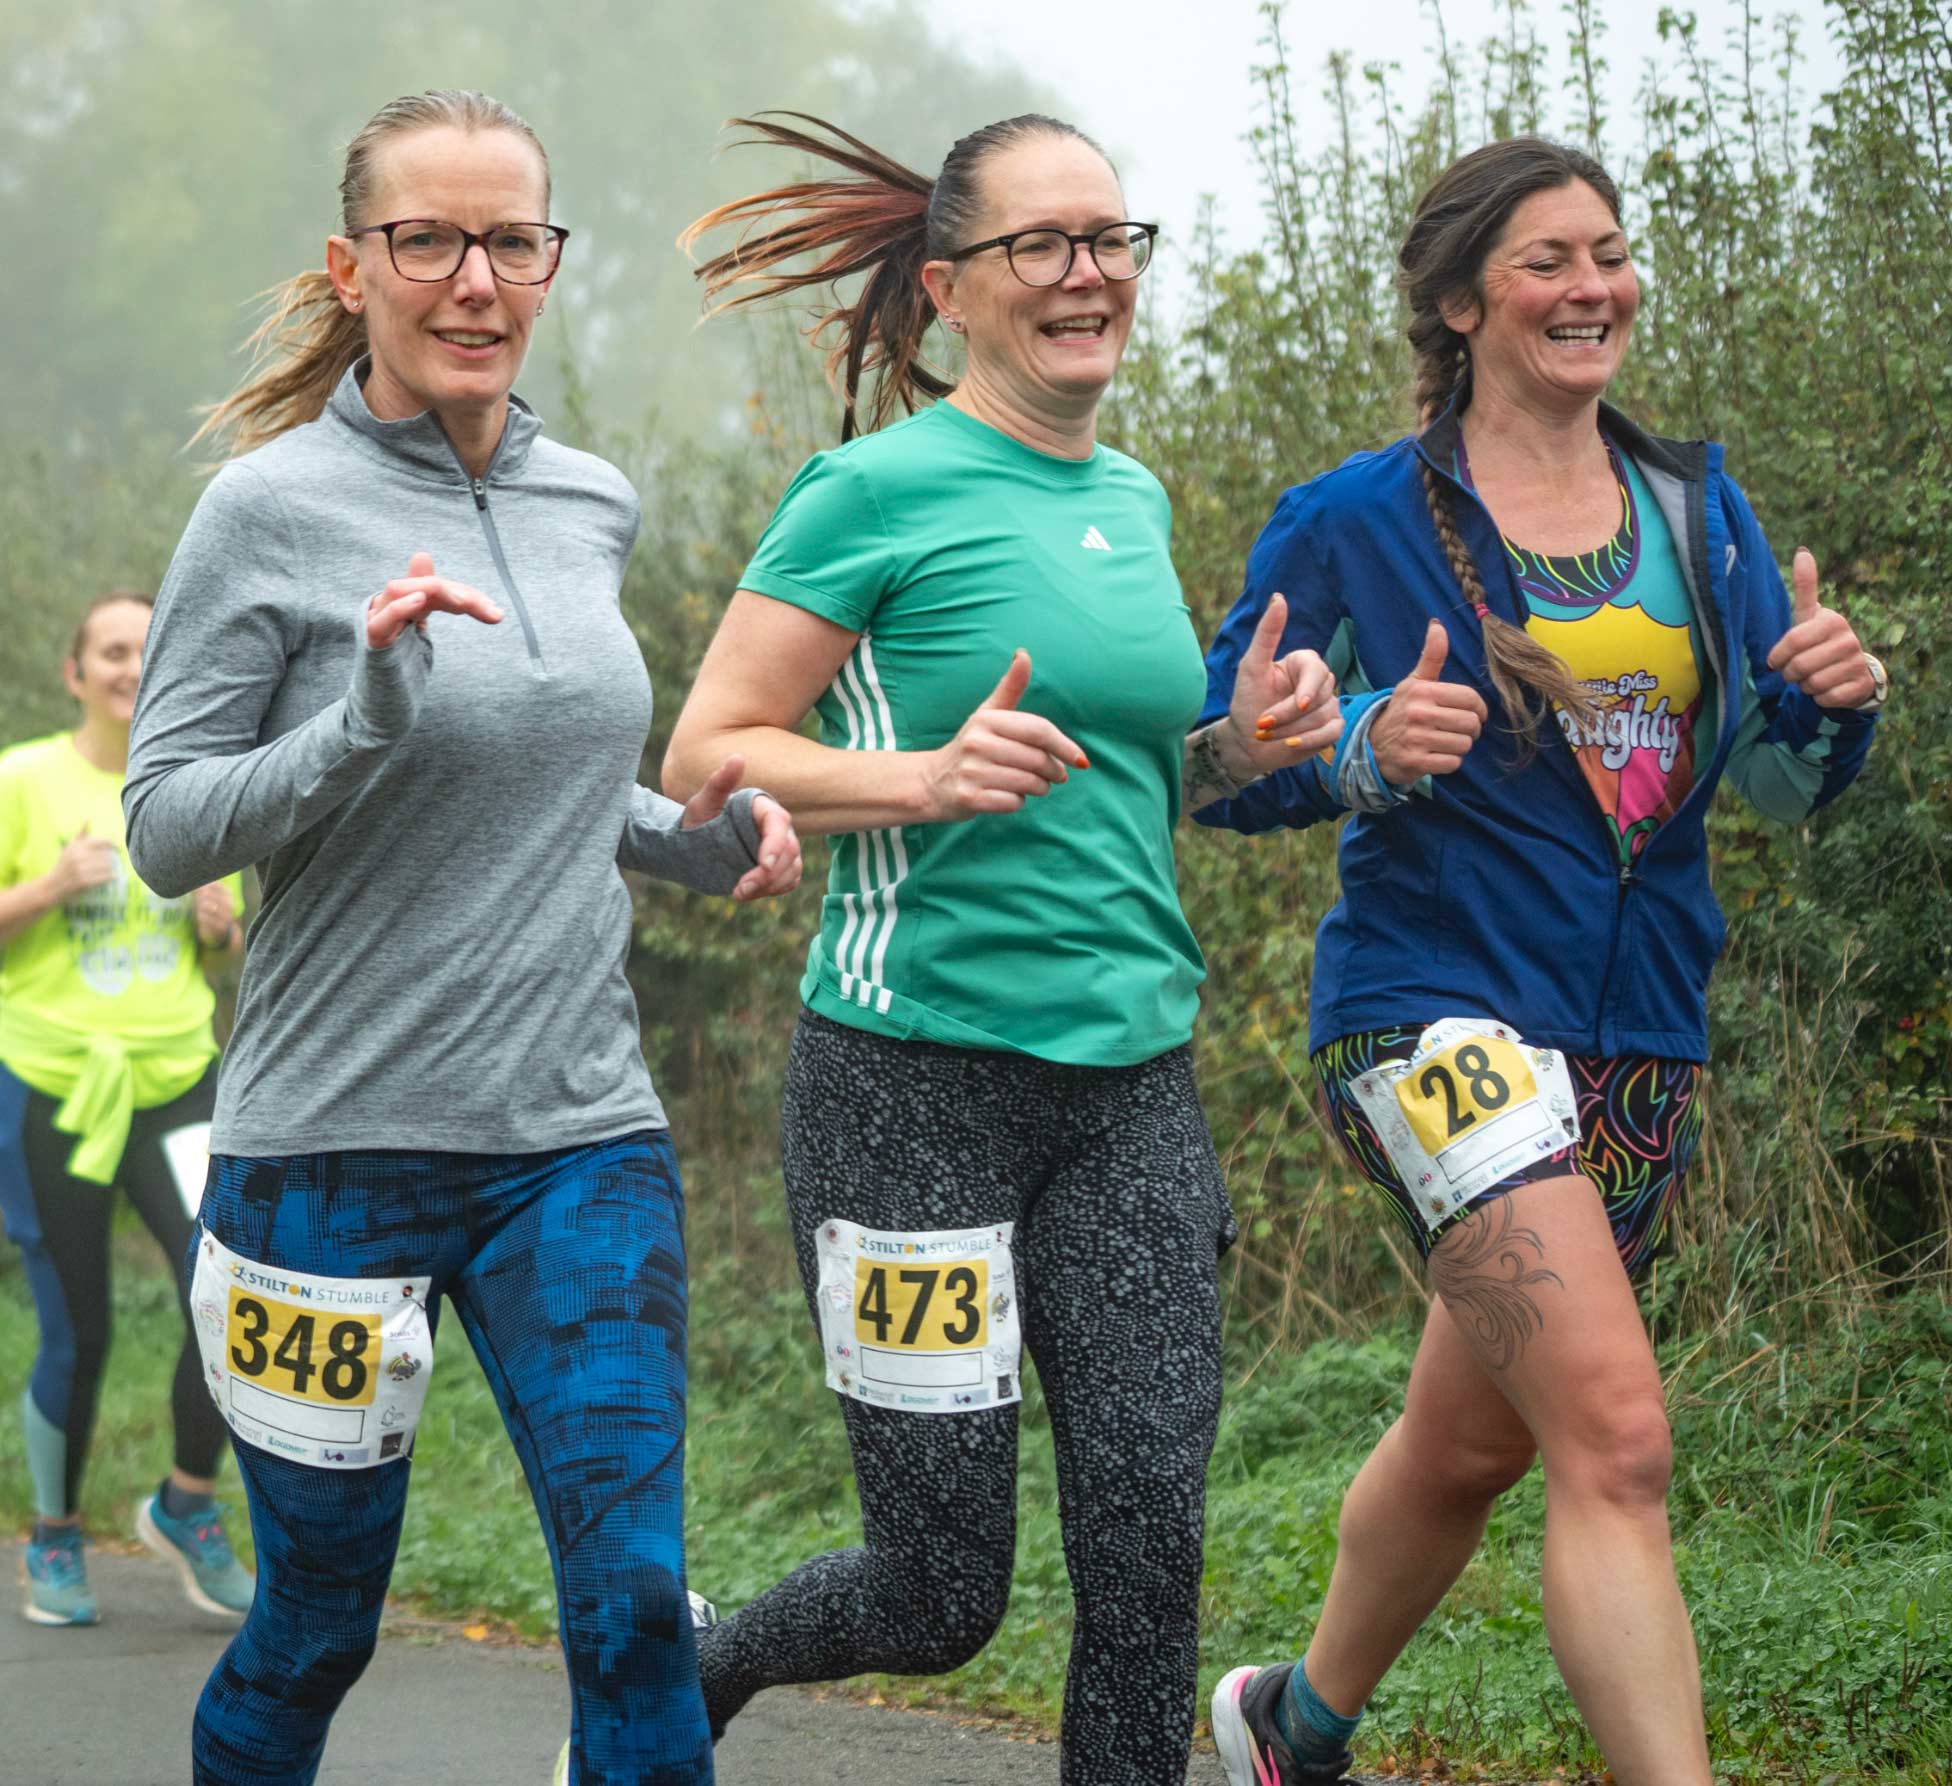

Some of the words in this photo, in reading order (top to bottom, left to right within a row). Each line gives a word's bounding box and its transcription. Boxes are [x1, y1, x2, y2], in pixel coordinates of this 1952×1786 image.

[1618, 670, 1657, 696] Miss
[1420, 1044, 1510, 1138] 28
[869, 1241, 926, 1254] STILTON
[930, 1237, 992, 1251] STUMBLE
[249, 1272, 312, 1299] STILTON
[317, 1289, 390, 1304] STUMBLE
[859, 1266, 980, 1345] 473
[231, 1297, 369, 1400] 348
